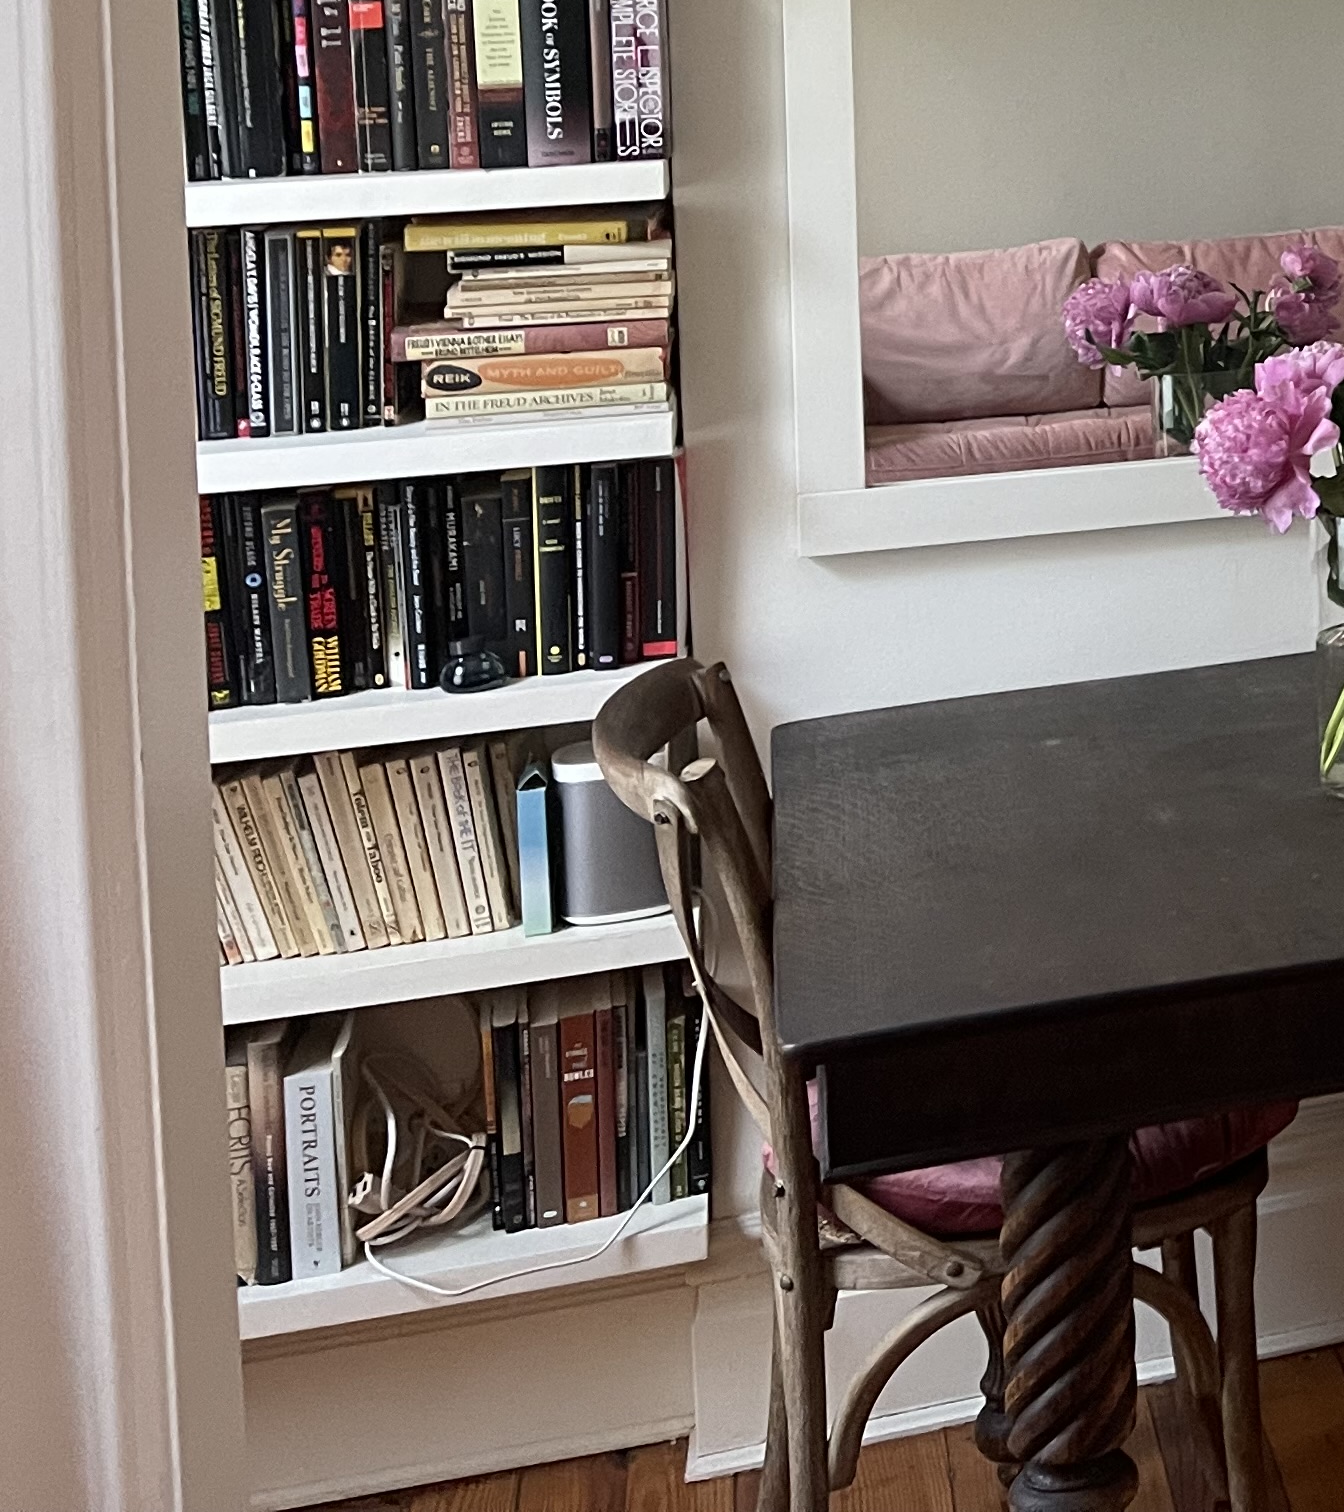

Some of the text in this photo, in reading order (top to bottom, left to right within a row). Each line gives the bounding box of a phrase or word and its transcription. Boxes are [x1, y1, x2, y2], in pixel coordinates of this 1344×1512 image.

[542, 47, 564, 140] SYMBOLS
[433, 372, 471, 385] REIK
[484, 365, 532, 380] MYTH
[536, 363, 569, 377] AND
[453, 399, 481, 412] THE
[483, 396, 527, 411] FREUD
[268, 517, 299, 613] My Struggle
[298, 1085, 321, 1198] PORTRAITS
